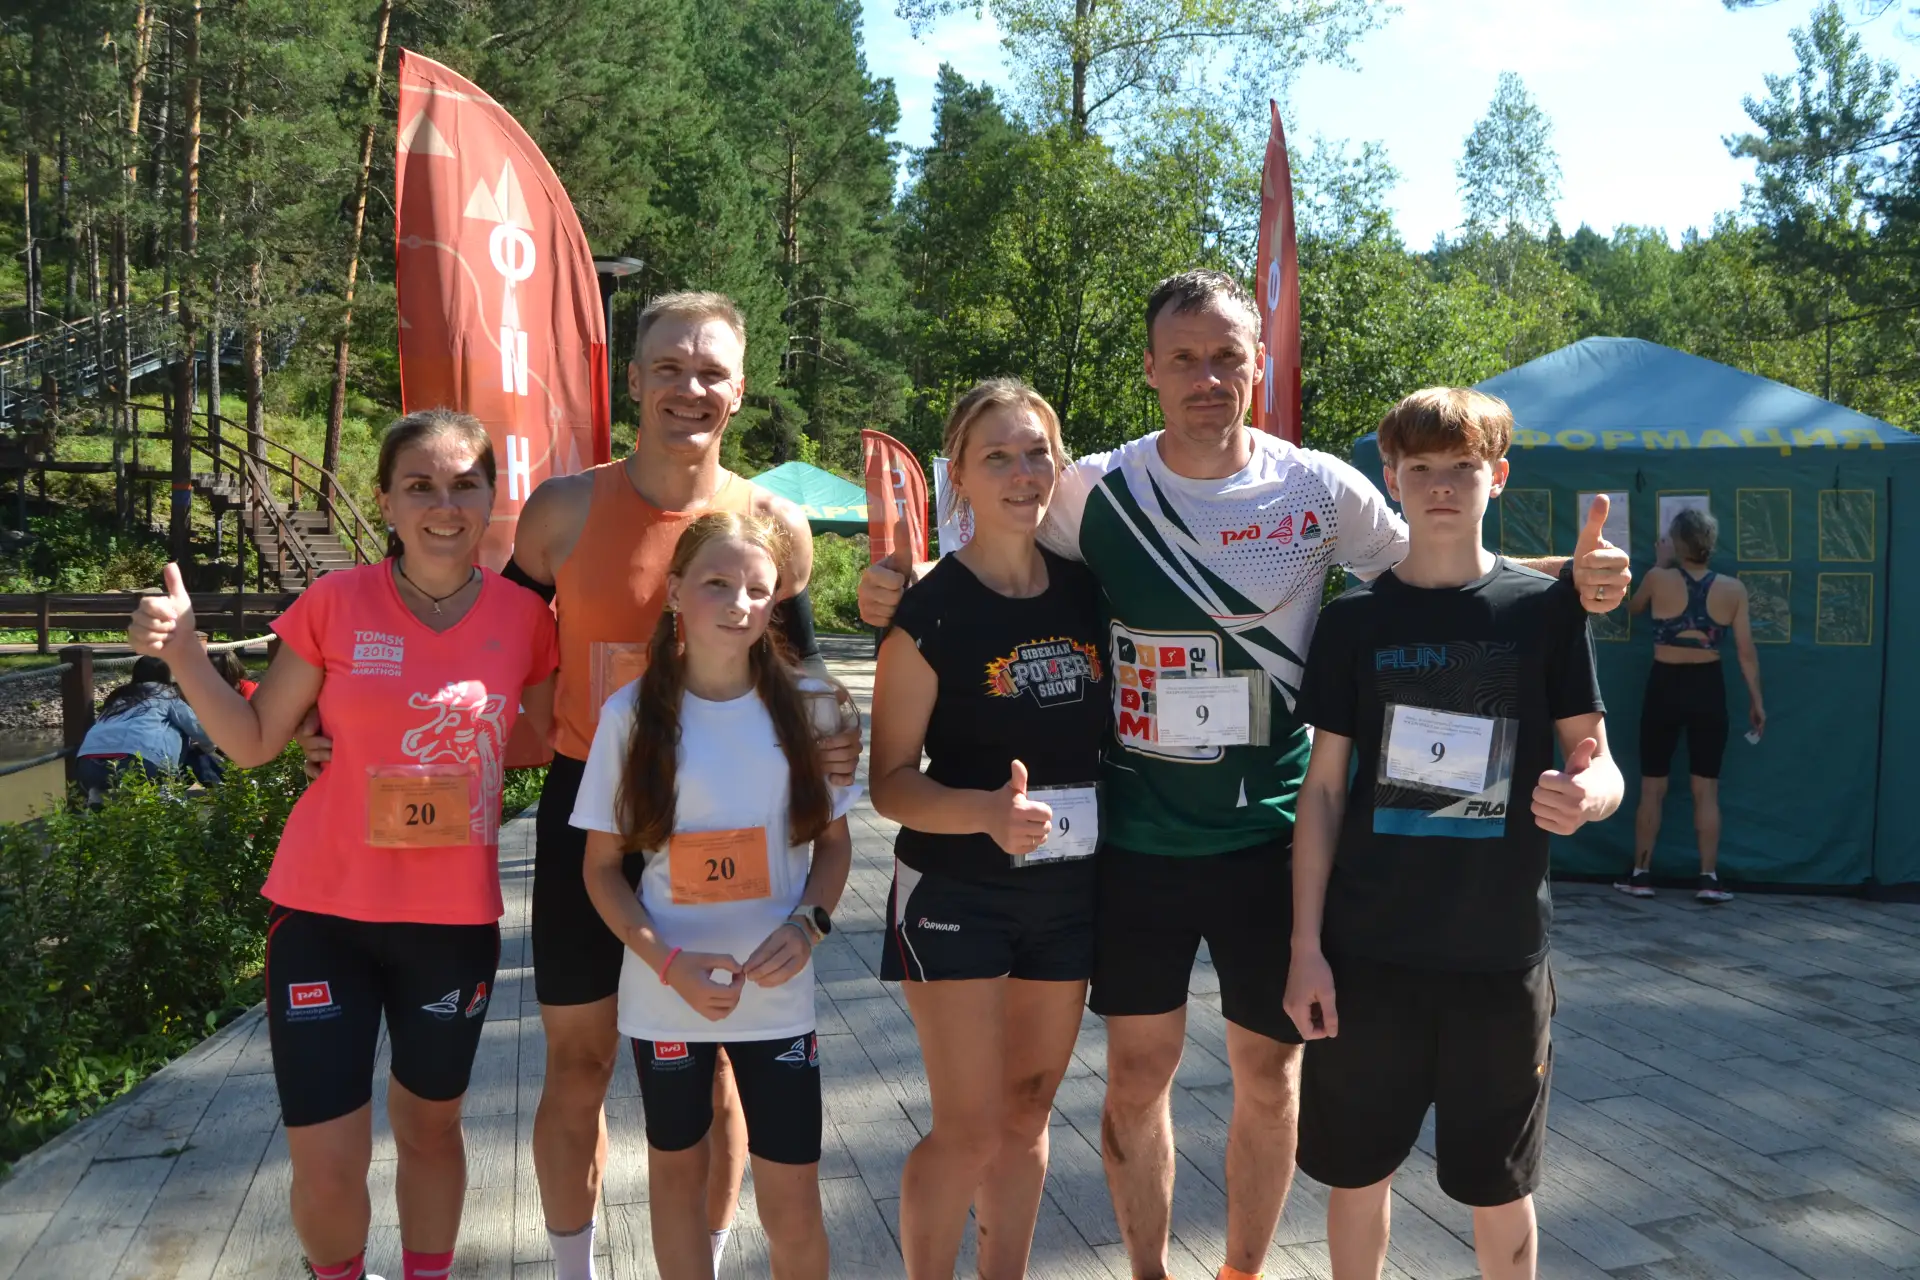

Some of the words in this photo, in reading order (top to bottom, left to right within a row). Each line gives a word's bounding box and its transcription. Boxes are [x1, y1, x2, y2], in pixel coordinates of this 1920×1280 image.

[1510, 429, 1885, 456] ФОРМАЦИЯ
[353, 630, 404, 646] TOMSK
[363, 646, 394, 658] 2019
[1021, 642, 1071, 660] SIBERIAN
[1376, 646, 1447, 671] RUN
[351, 667, 402, 677] MARATHON
[1012, 655, 1090, 687] POWER
[1038, 679, 1077, 697] SHOW
[1195, 705, 1210, 727] 9
[1430, 741, 1446, 763] 9
[405, 802, 436, 825] 20
[1464, 800, 1505, 817] FILA
[1059, 816, 1070, 837] 9
[705, 857, 735, 881] 20
[918, 917, 960, 932] FORWARD
